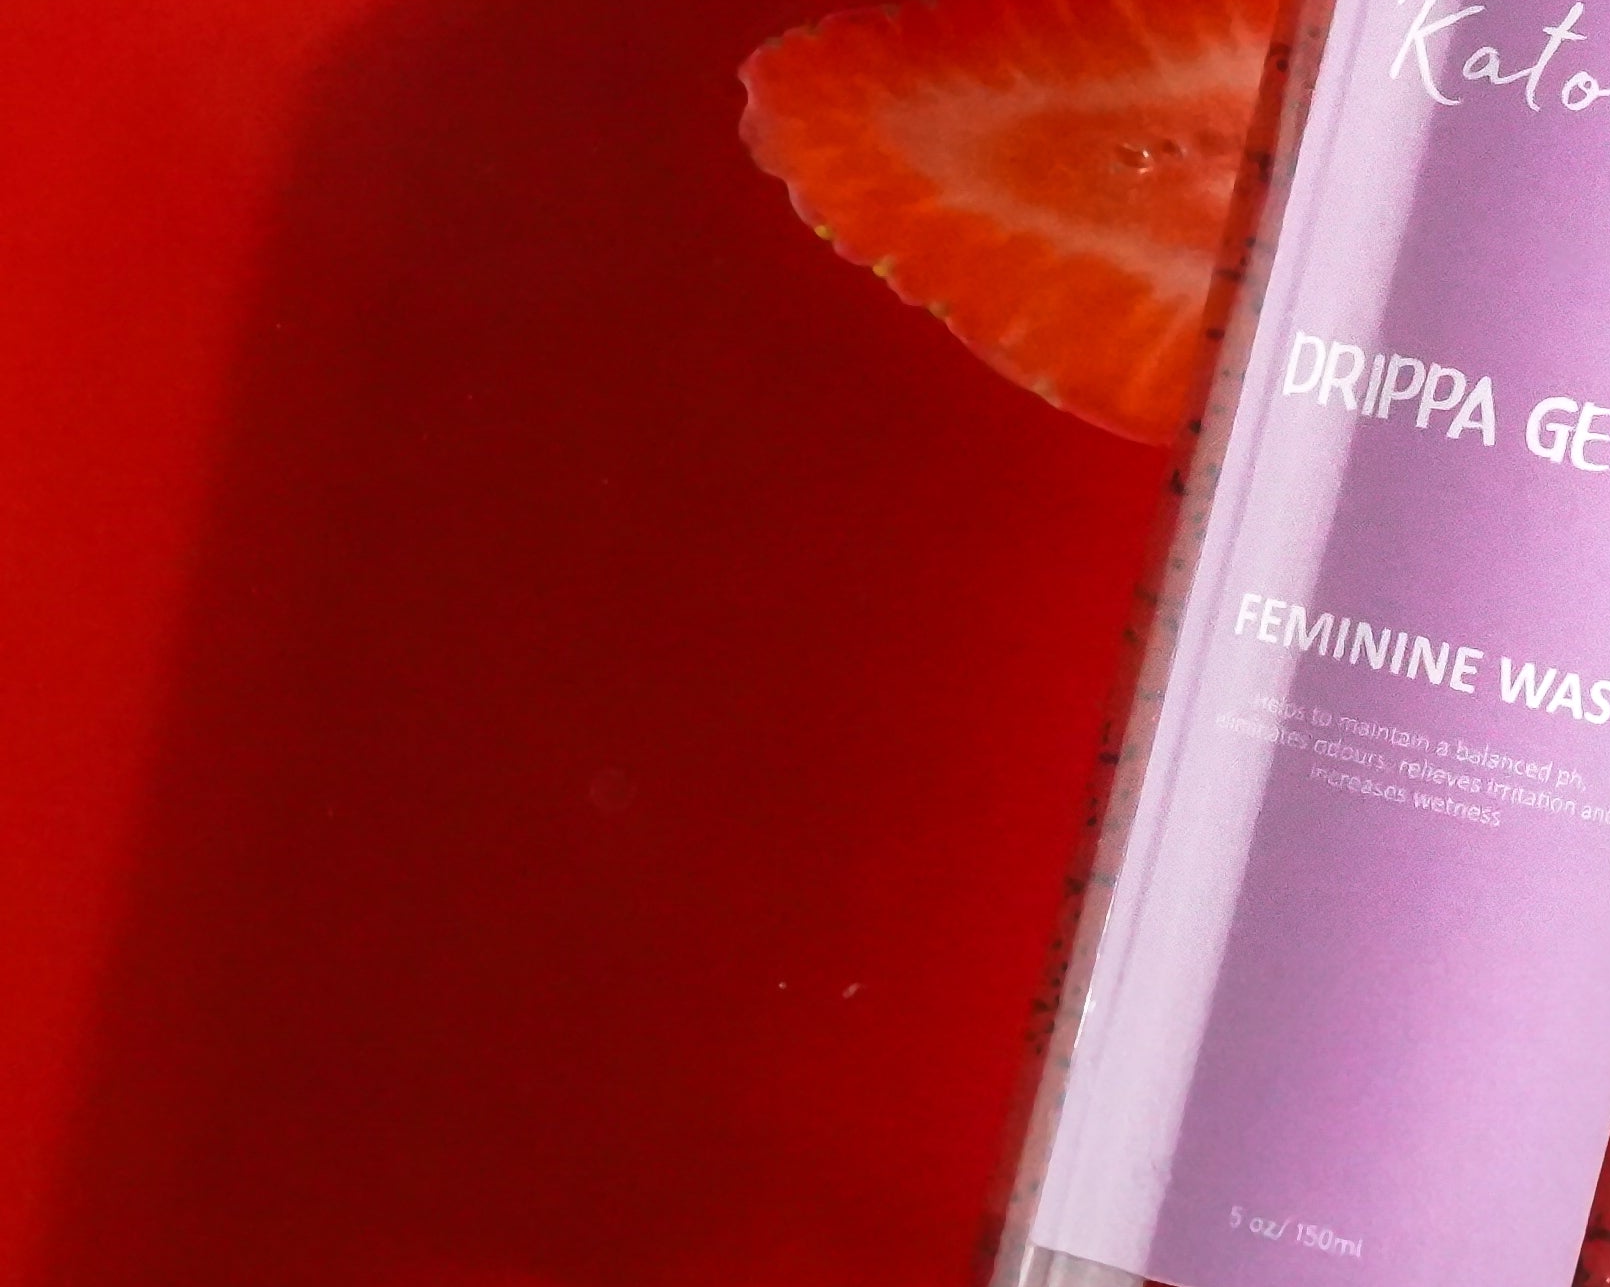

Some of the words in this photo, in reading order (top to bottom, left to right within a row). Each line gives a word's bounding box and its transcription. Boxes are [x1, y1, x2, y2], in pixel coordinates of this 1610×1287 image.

[1282, 331, 1496, 447] DRIPPA
[1233, 592, 1485, 695] FEMININE
[1312, 706, 1333, 727] to
[1340, 715, 1431, 752] maintain
[1435, 739, 1451, 757] a
[1455, 739, 1553, 784] balanced
[1309, 764, 1407, 803] increases
[1413, 790, 1501, 827] wetness
[1399, 758, 1483, 794] relieves
[1487, 775, 1577, 815] irritation
[1228, 1204, 1244, 1230] 5
[1295, 1222, 1364, 1259] 150ml
